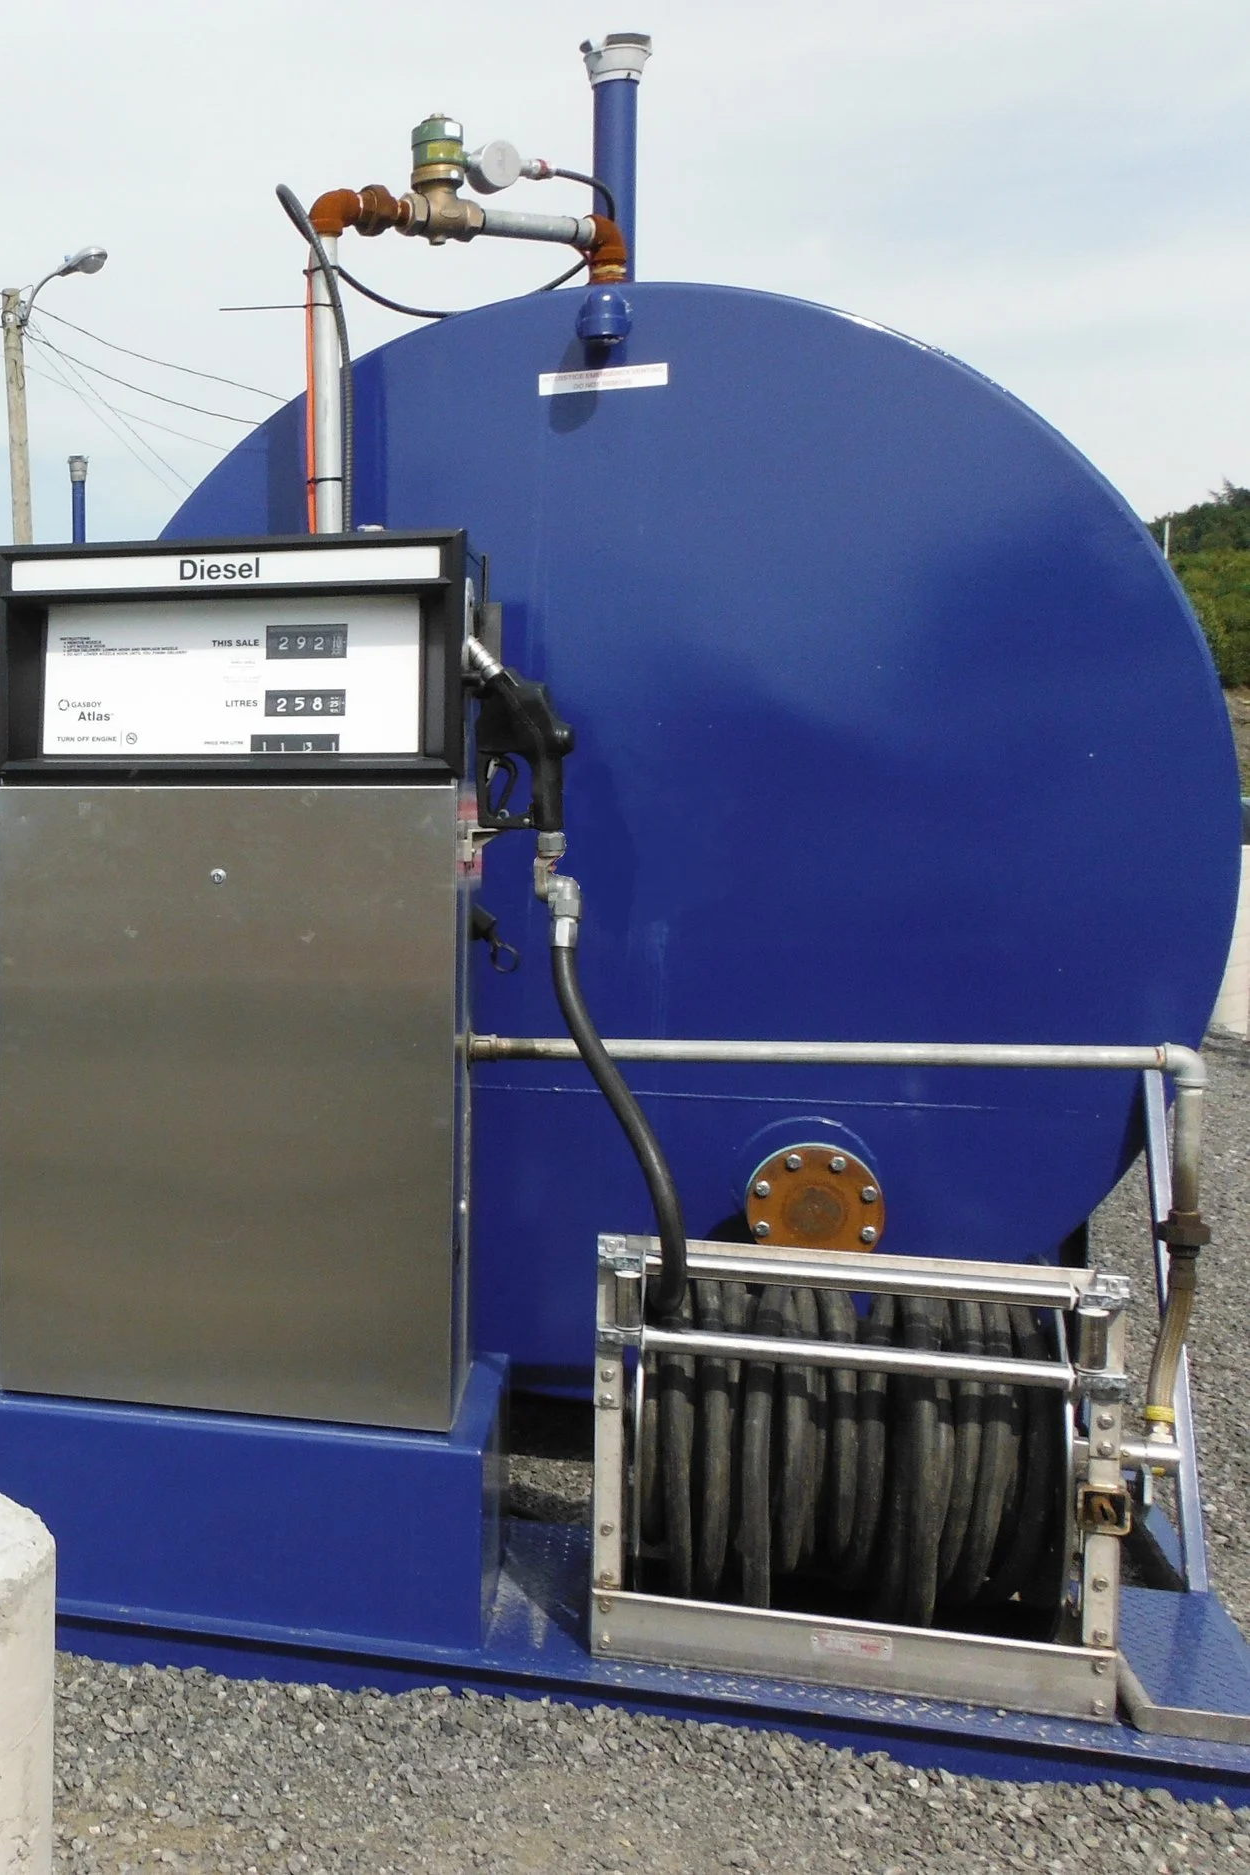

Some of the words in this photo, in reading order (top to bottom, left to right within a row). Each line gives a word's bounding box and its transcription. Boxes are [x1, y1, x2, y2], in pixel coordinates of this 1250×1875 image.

[180, 557, 260, 580] Diesel
[236, 639, 260, 647] SALE
[225, 699, 258, 707] LITRES
[78, 711, 111, 721] Atlas
